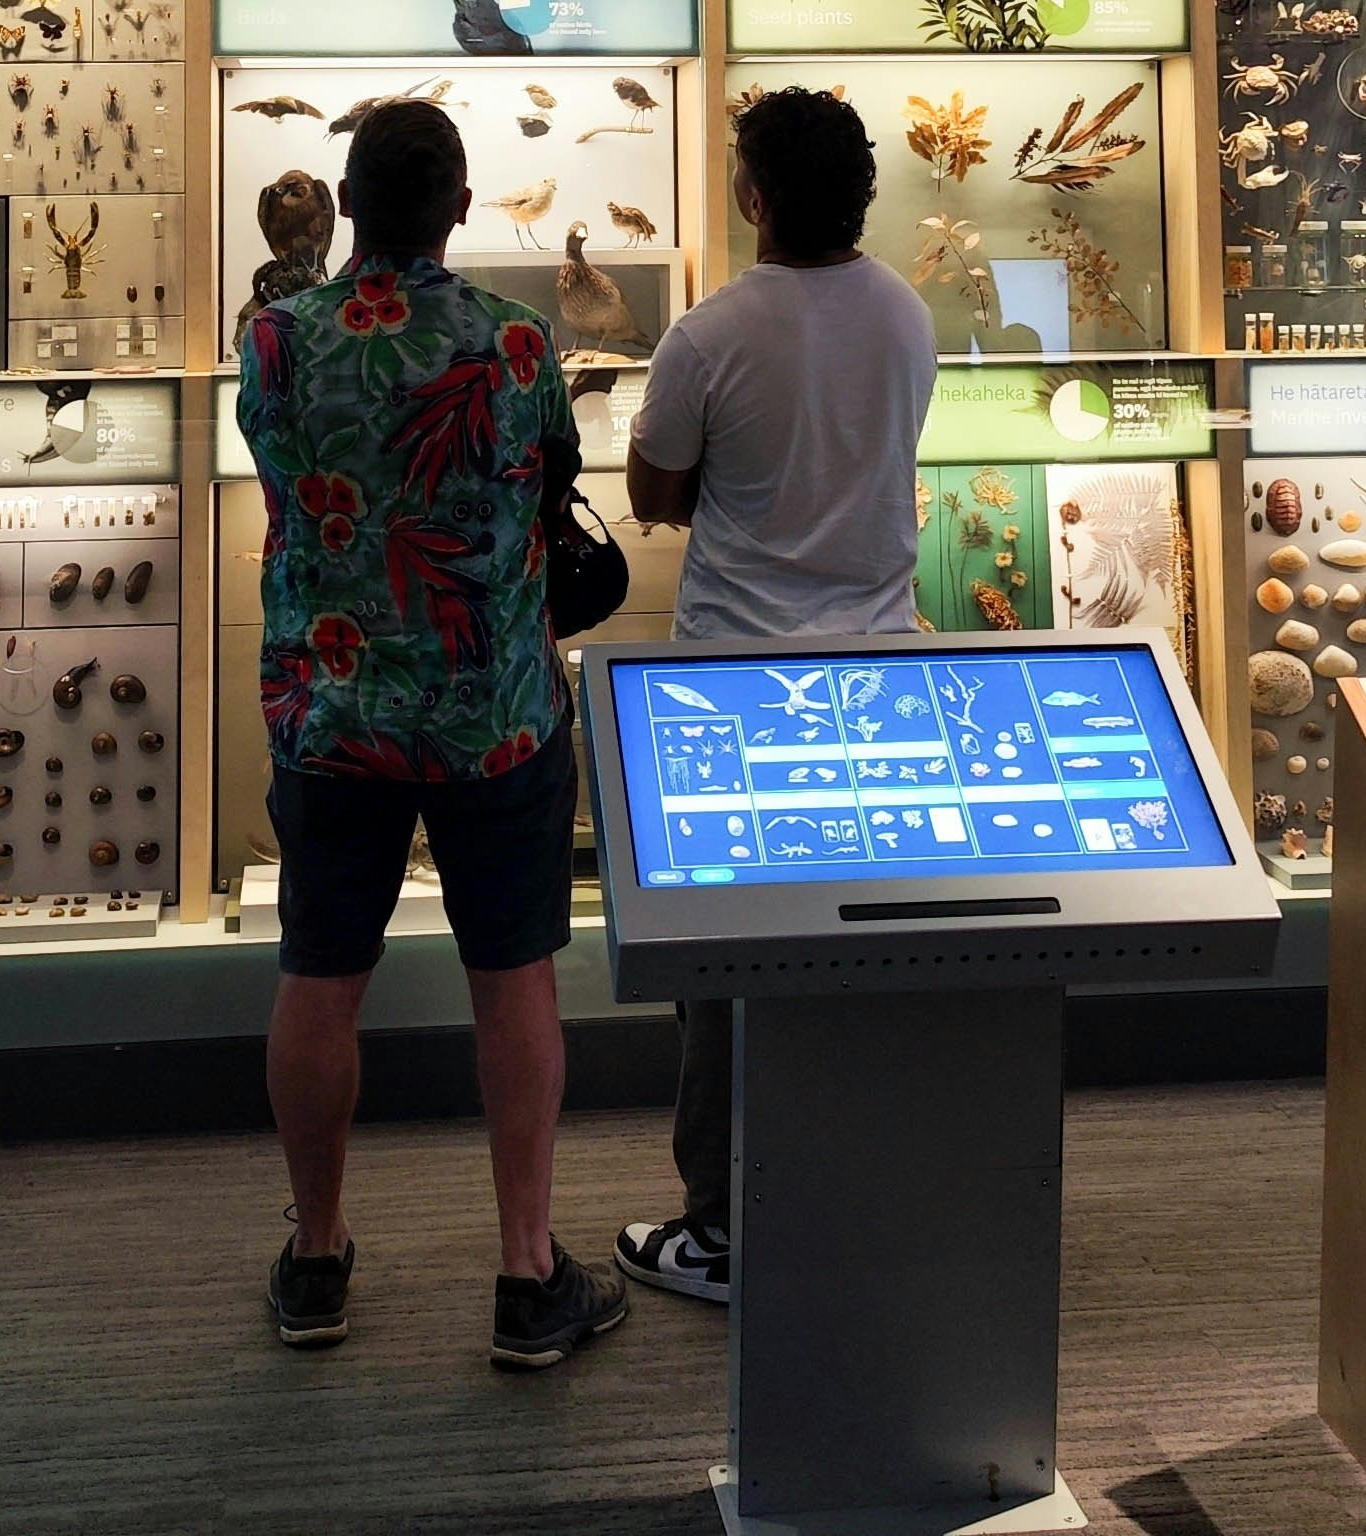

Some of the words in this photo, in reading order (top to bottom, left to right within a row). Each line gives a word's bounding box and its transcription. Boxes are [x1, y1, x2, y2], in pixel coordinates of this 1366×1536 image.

[549, 2, 584, 16] 73%
[1094, 1, 1128, 14] 85%
[748, 9, 792, 26] Seed
[797, 8, 853, 28] plants
[939, 383, 1026, 402] hekaheka
[1270, 384, 1294, 400] He
[1113, 404, 1149, 418] 30%
[96, 428, 136, 443] 80%
